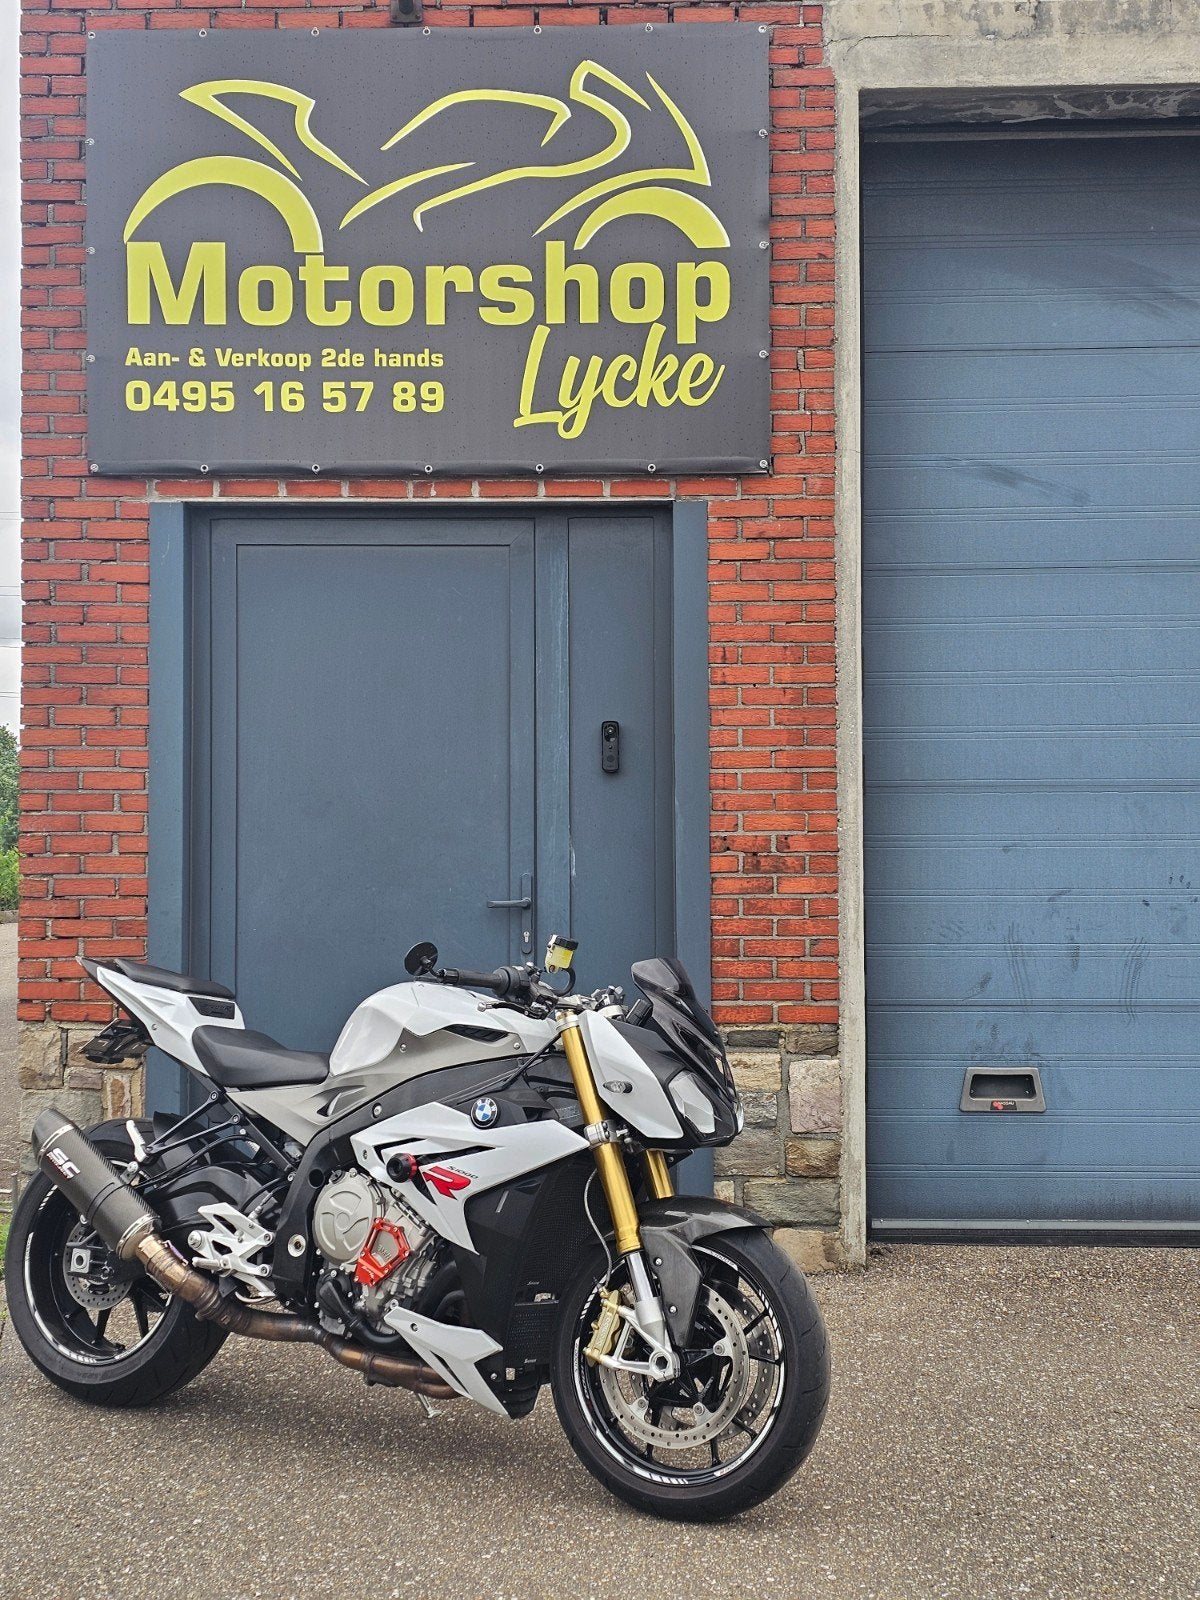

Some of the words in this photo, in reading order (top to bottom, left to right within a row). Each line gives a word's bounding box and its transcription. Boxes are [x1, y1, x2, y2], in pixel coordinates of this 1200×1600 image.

[126, 241, 731, 345] Motorshop
[125, 348, 181, 366] Aan-
[188, 349, 206, 367] &
[215, 349, 312, 371] Verkoop
[321, 349, 364, 367] 2de
[373, 349, 444, 368] hands
[125, 380, 235, 412] 0495
[253, 380, 305, 413] 16
[322, 380, 374, 413] 57
[392, 380, 445, 413] 89
[513, 321, 725, 440] Lycke
[418, 1165, 471, 1200] R
